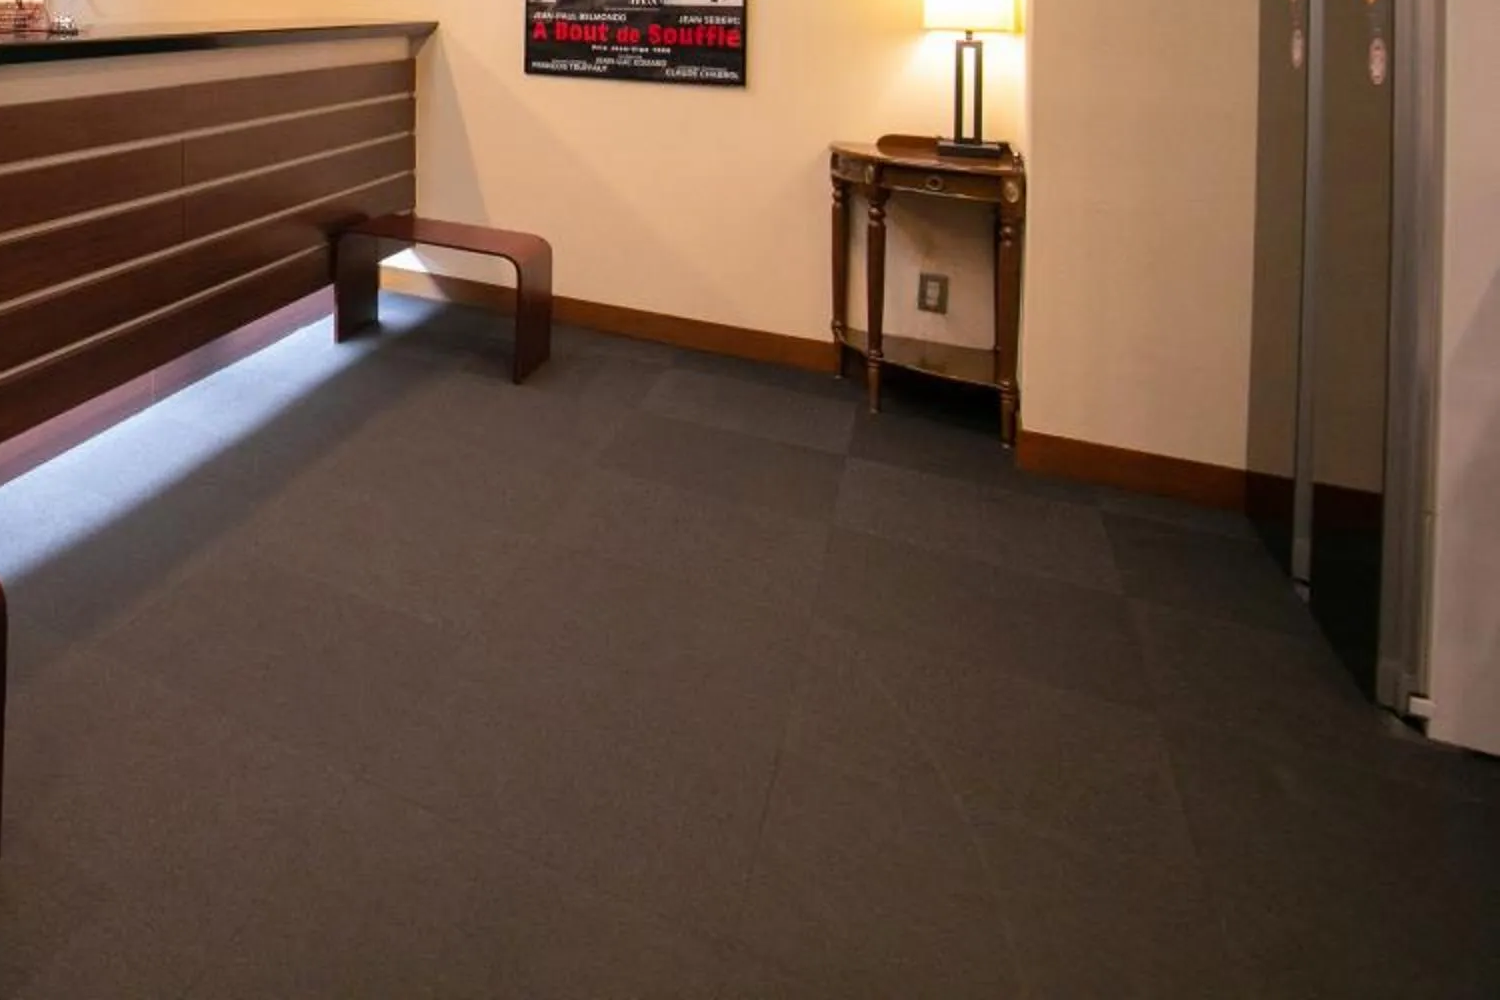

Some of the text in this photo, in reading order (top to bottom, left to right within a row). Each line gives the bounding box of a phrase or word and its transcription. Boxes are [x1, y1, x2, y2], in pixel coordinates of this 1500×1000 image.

[532, 21, 741, 47] A Bout de Souffle
